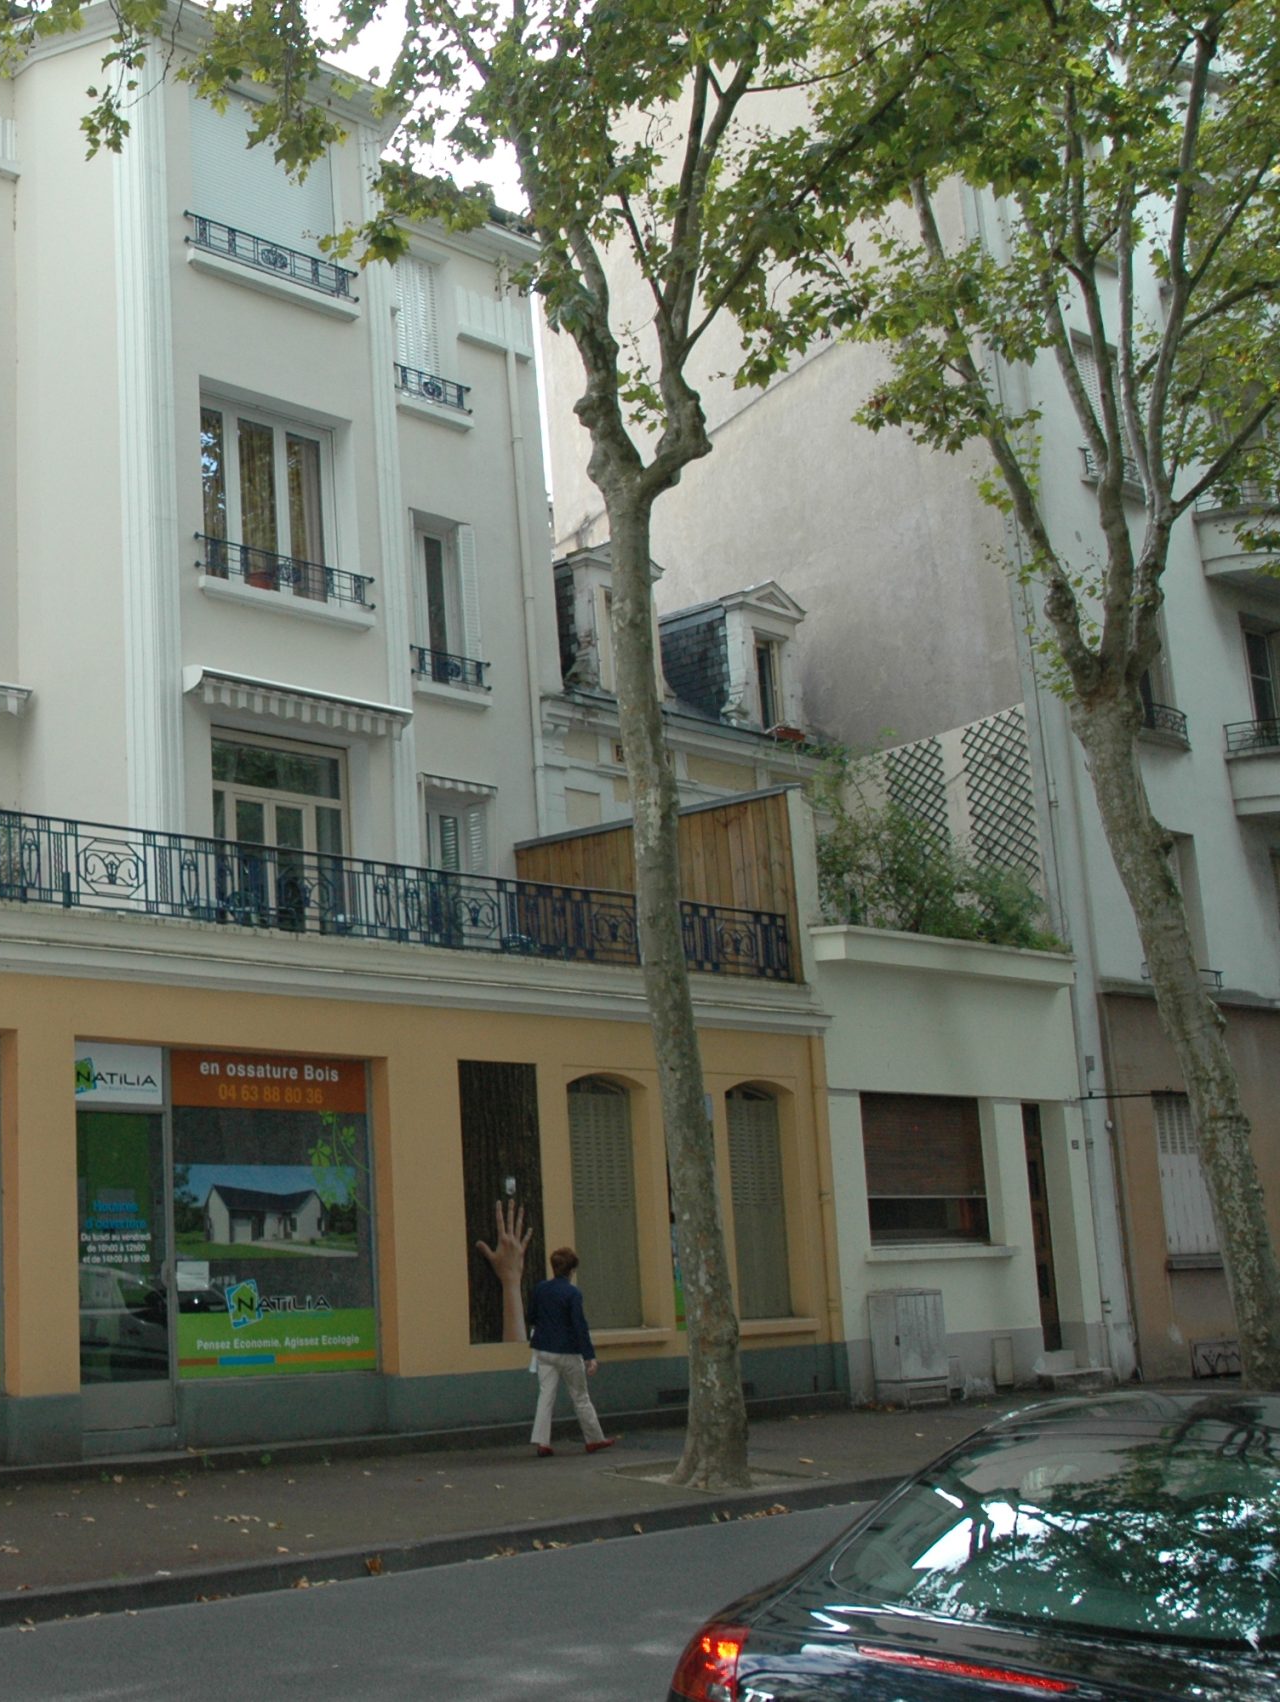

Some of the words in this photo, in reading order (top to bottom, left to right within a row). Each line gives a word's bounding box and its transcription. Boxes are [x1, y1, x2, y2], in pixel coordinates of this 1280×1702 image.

[200, 1062, 220, 1075] en
[226, 1063, 298, 1080] ossature
[304, 1065, 339, 1082] Bois
[218, 1084, 237, 1100] 04
[241, 1085, 258, 1101] 63
[263, 1086, 280, 1102] 88
[284, 1087, 302, 1103] 80
[306, 1088, 324, 1104] 36
[196, 1338, 230, 1350] Pensez
[233, 1337, 281, 1350] Economie,
[284, 1336, 319, 1349] Agissez
[322, 1333, 360, 1347] Ecologie
